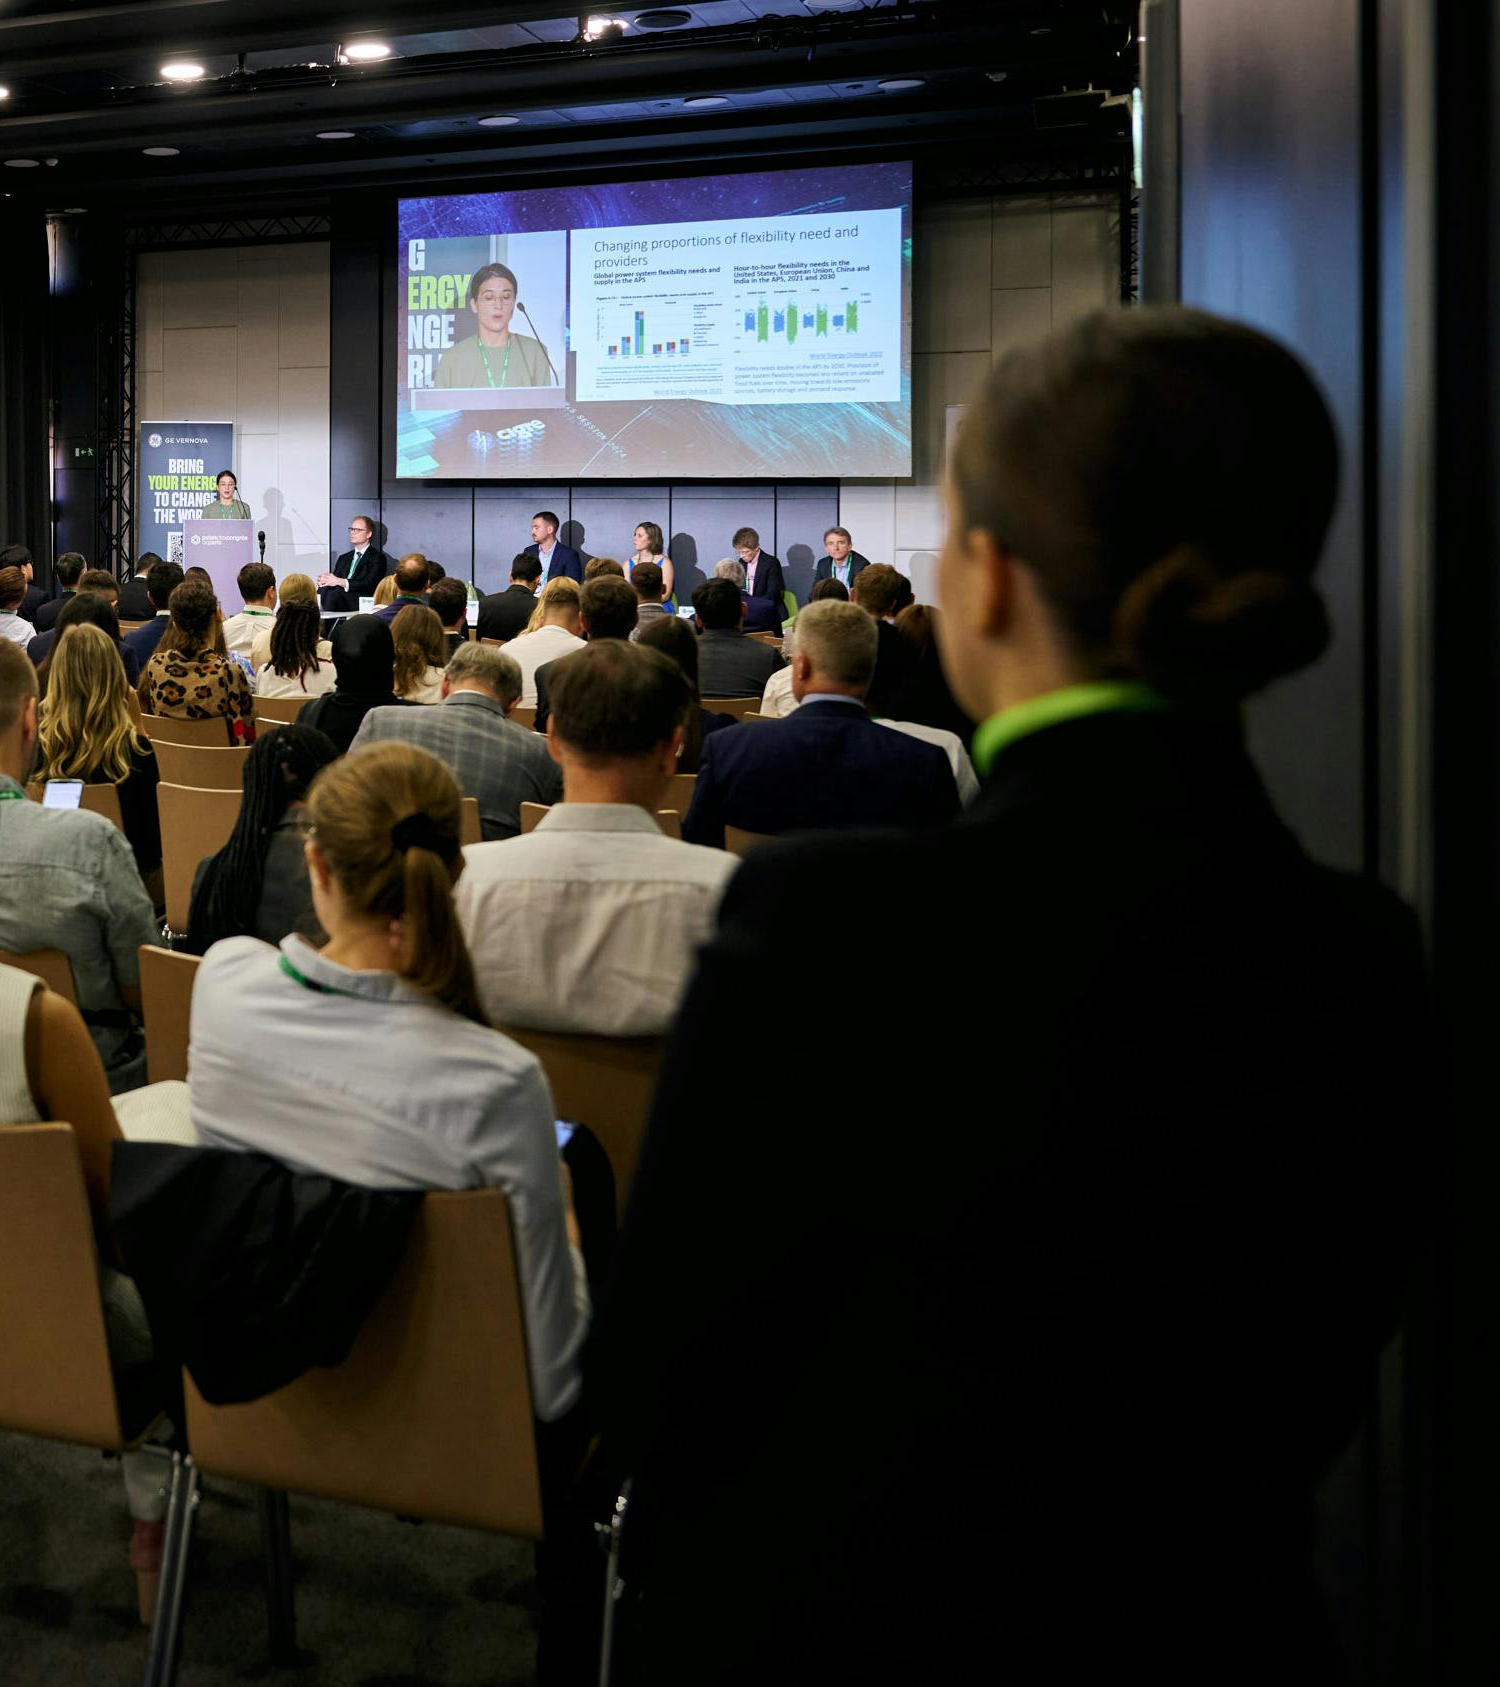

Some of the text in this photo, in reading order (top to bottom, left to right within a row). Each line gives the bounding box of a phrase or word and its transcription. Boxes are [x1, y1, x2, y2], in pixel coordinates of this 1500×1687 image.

[595, 225, 859, 252] Changing proportions of flexibility need and
[595, 256, 648, 270] providers
[778, 262, 808, 270] flexibility
[780, 268, 811, 276] European
[408, 274, 472, 310] ERGY
[168, 459, 204, 474] BRING
[148, 475, 218, 491] YOUR ENERG
[154, 492, 169, 507] TO
[154, 509, 176, 523] THE
